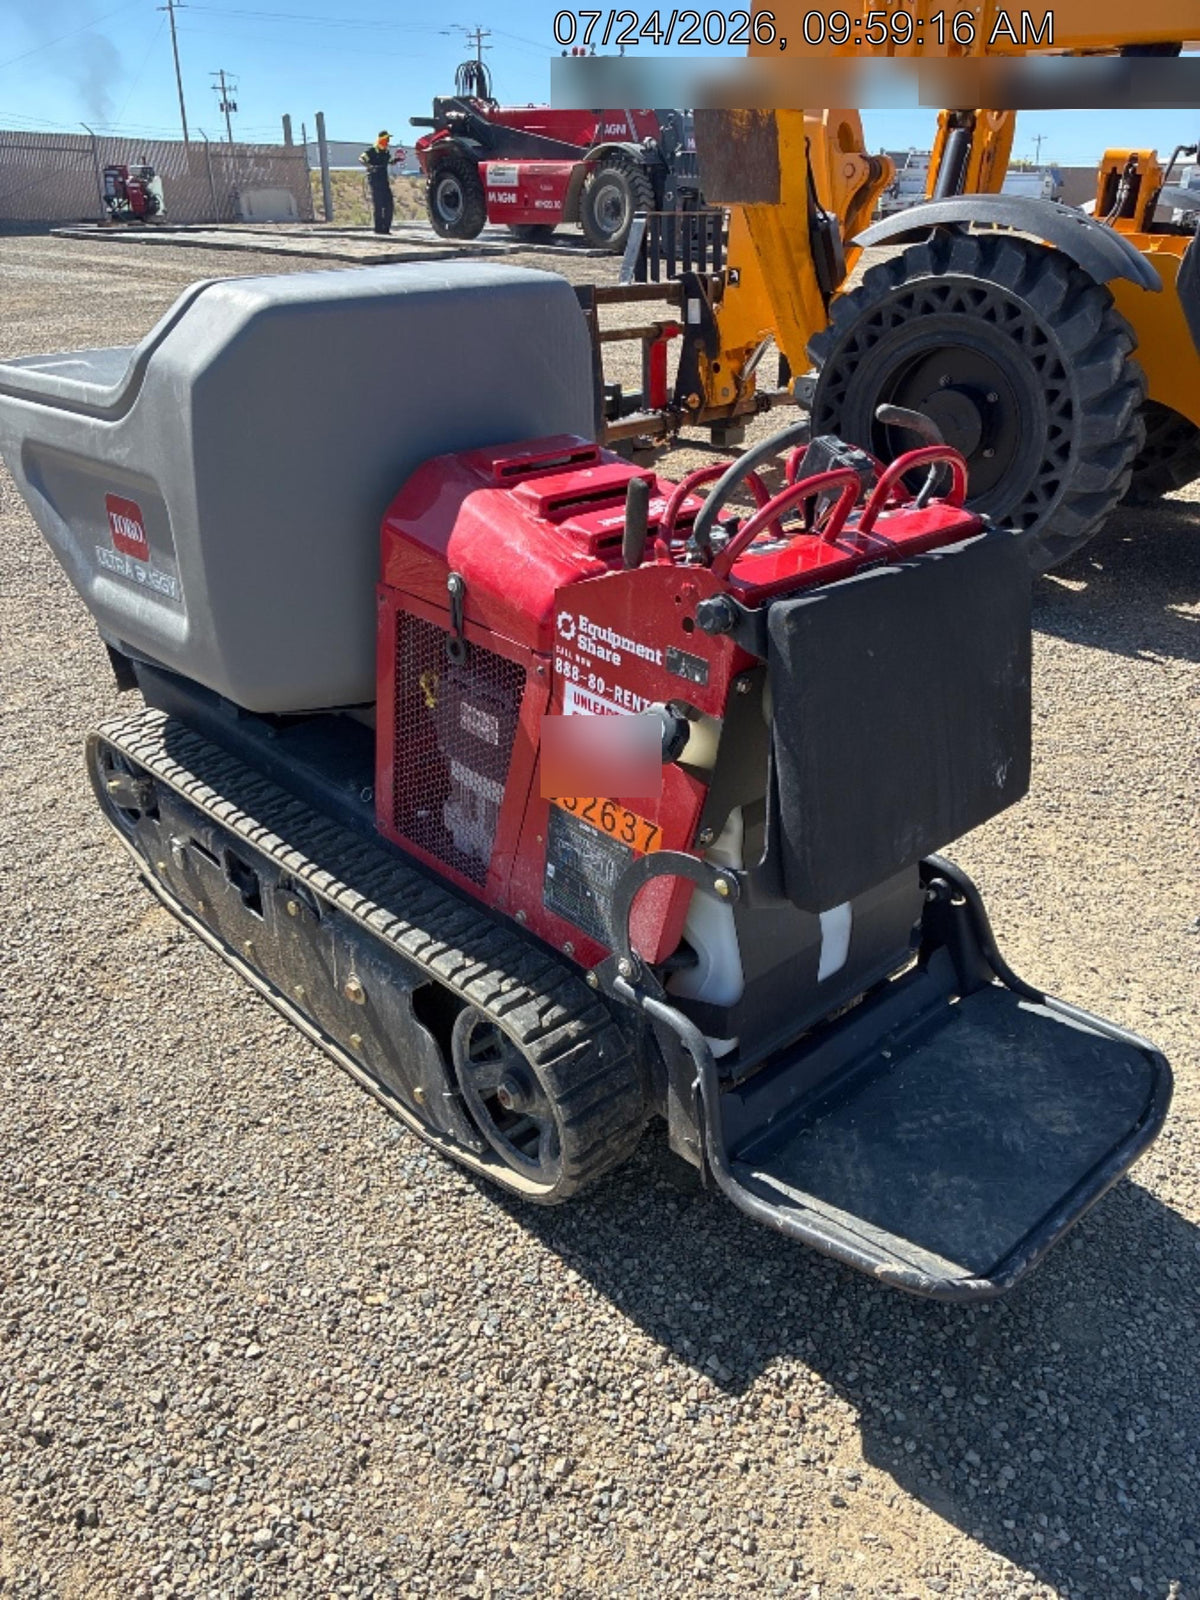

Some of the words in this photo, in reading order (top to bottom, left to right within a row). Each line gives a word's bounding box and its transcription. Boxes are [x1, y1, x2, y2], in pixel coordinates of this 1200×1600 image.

[109, 511, 144, 543] TORO
[577, 614, 663, 666] Equipment
[577, 634, 622, 666] Share
